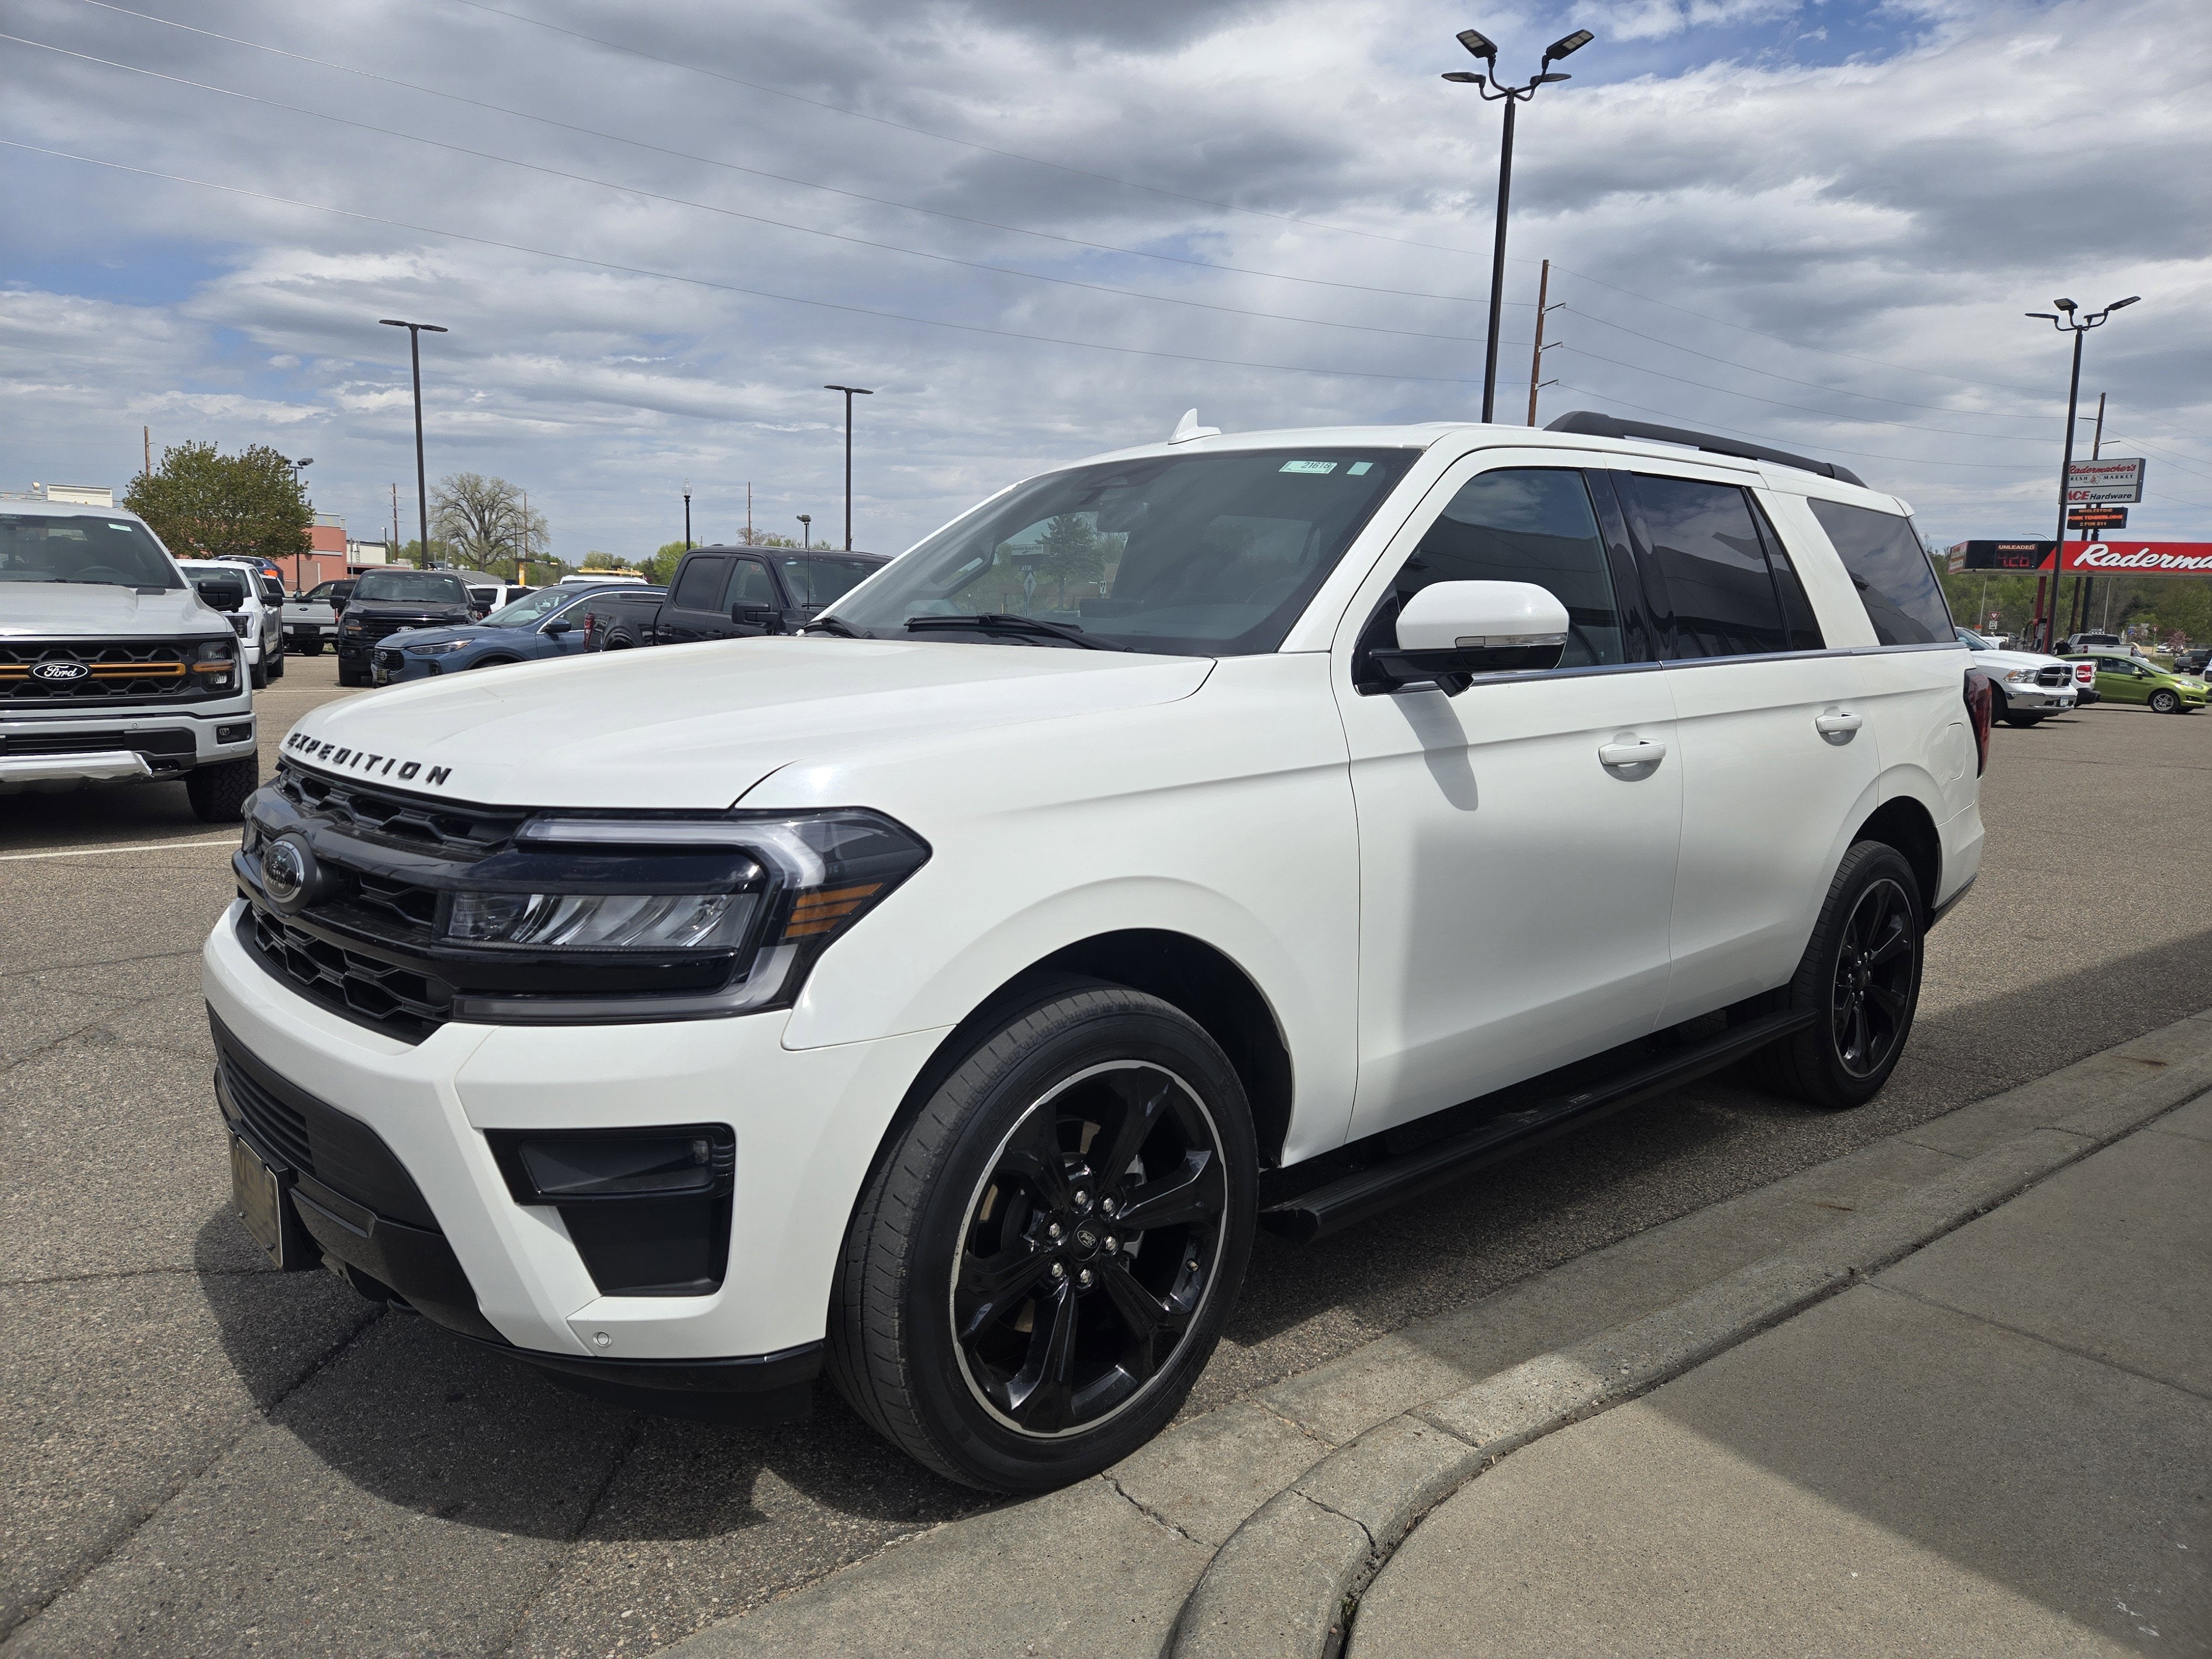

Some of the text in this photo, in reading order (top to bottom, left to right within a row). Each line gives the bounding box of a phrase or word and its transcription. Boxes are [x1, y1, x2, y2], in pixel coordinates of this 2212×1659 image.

[2070, 464, 2137, 474] Radermacher's
[2068, 490, 2090, 500] ACE
[44, 665, 77, 677] Ford
[286, 732, 452, 786] EXPEDITION
[1080, 1232, 1096, 1246] Ford
